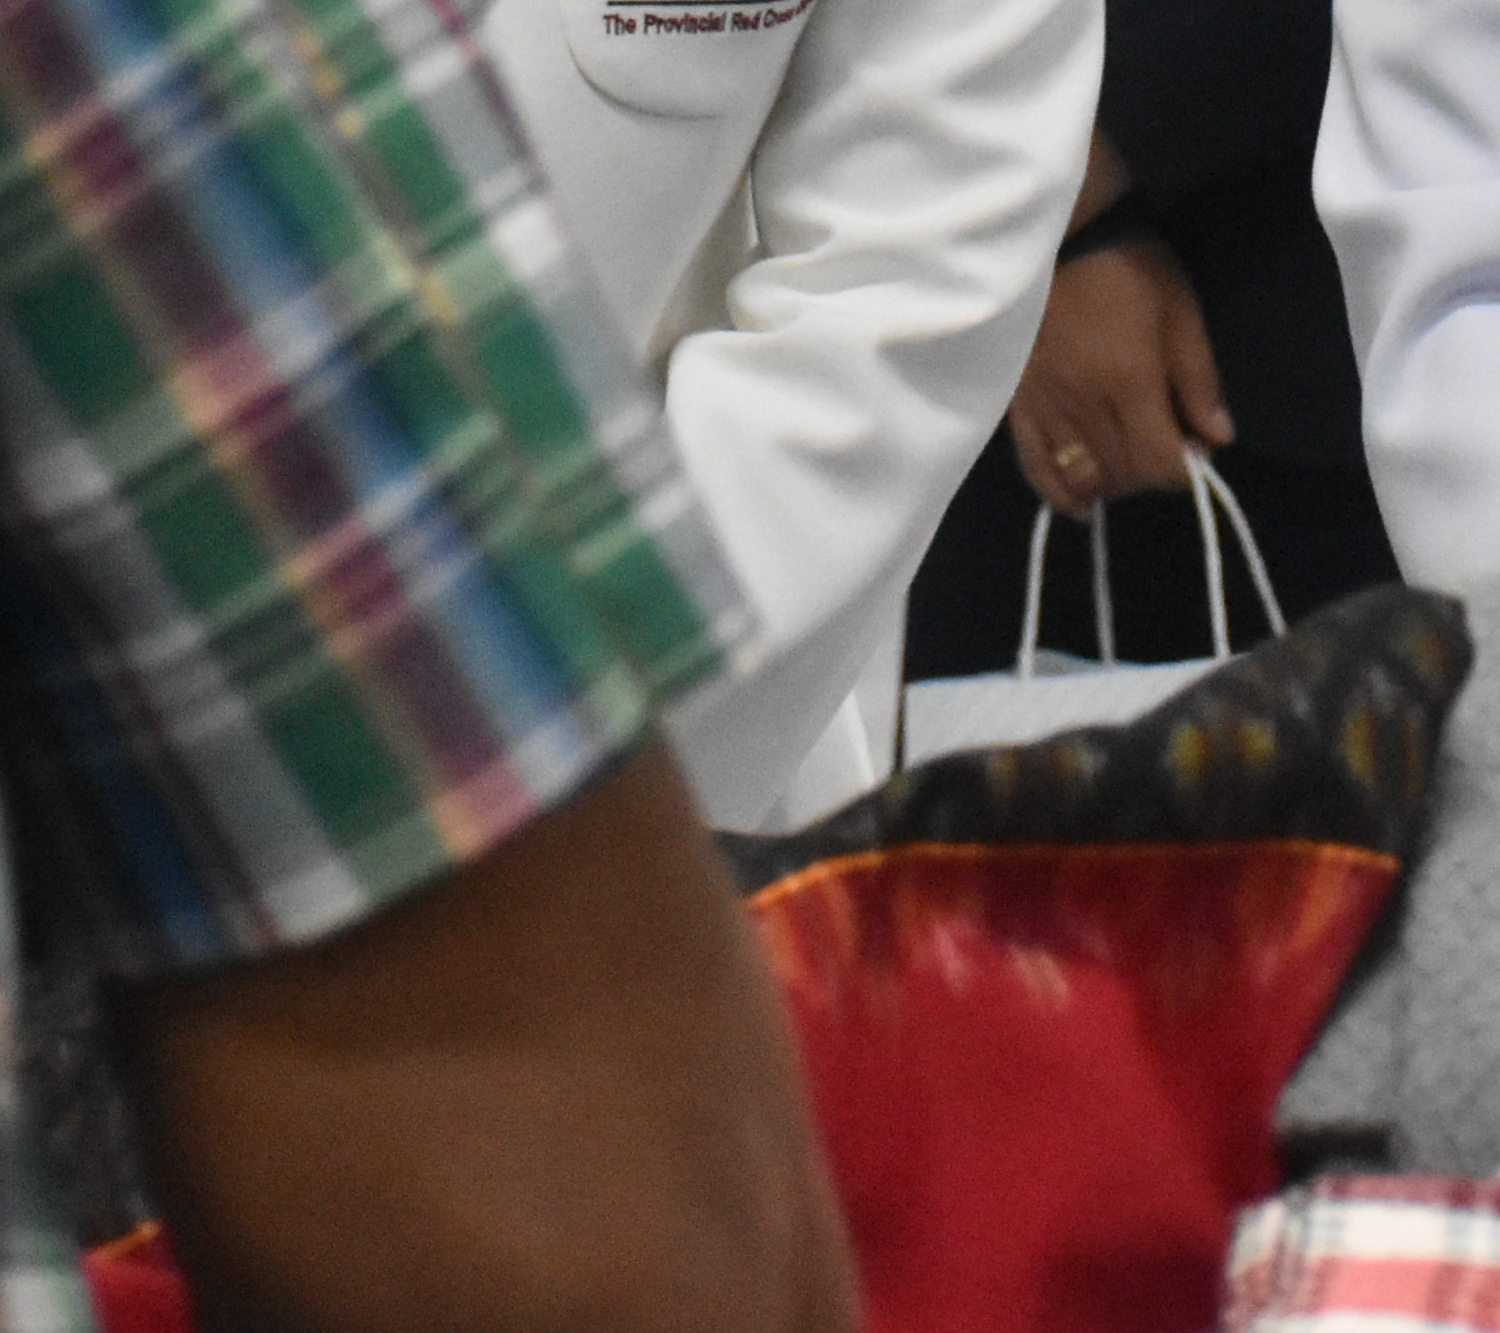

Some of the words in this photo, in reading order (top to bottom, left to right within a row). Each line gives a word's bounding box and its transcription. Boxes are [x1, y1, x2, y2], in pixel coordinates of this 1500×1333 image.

[603, 13, 637, 35] The
[644, 11, 726, 35] Provincial
[731, 11, 761, 32] Red
